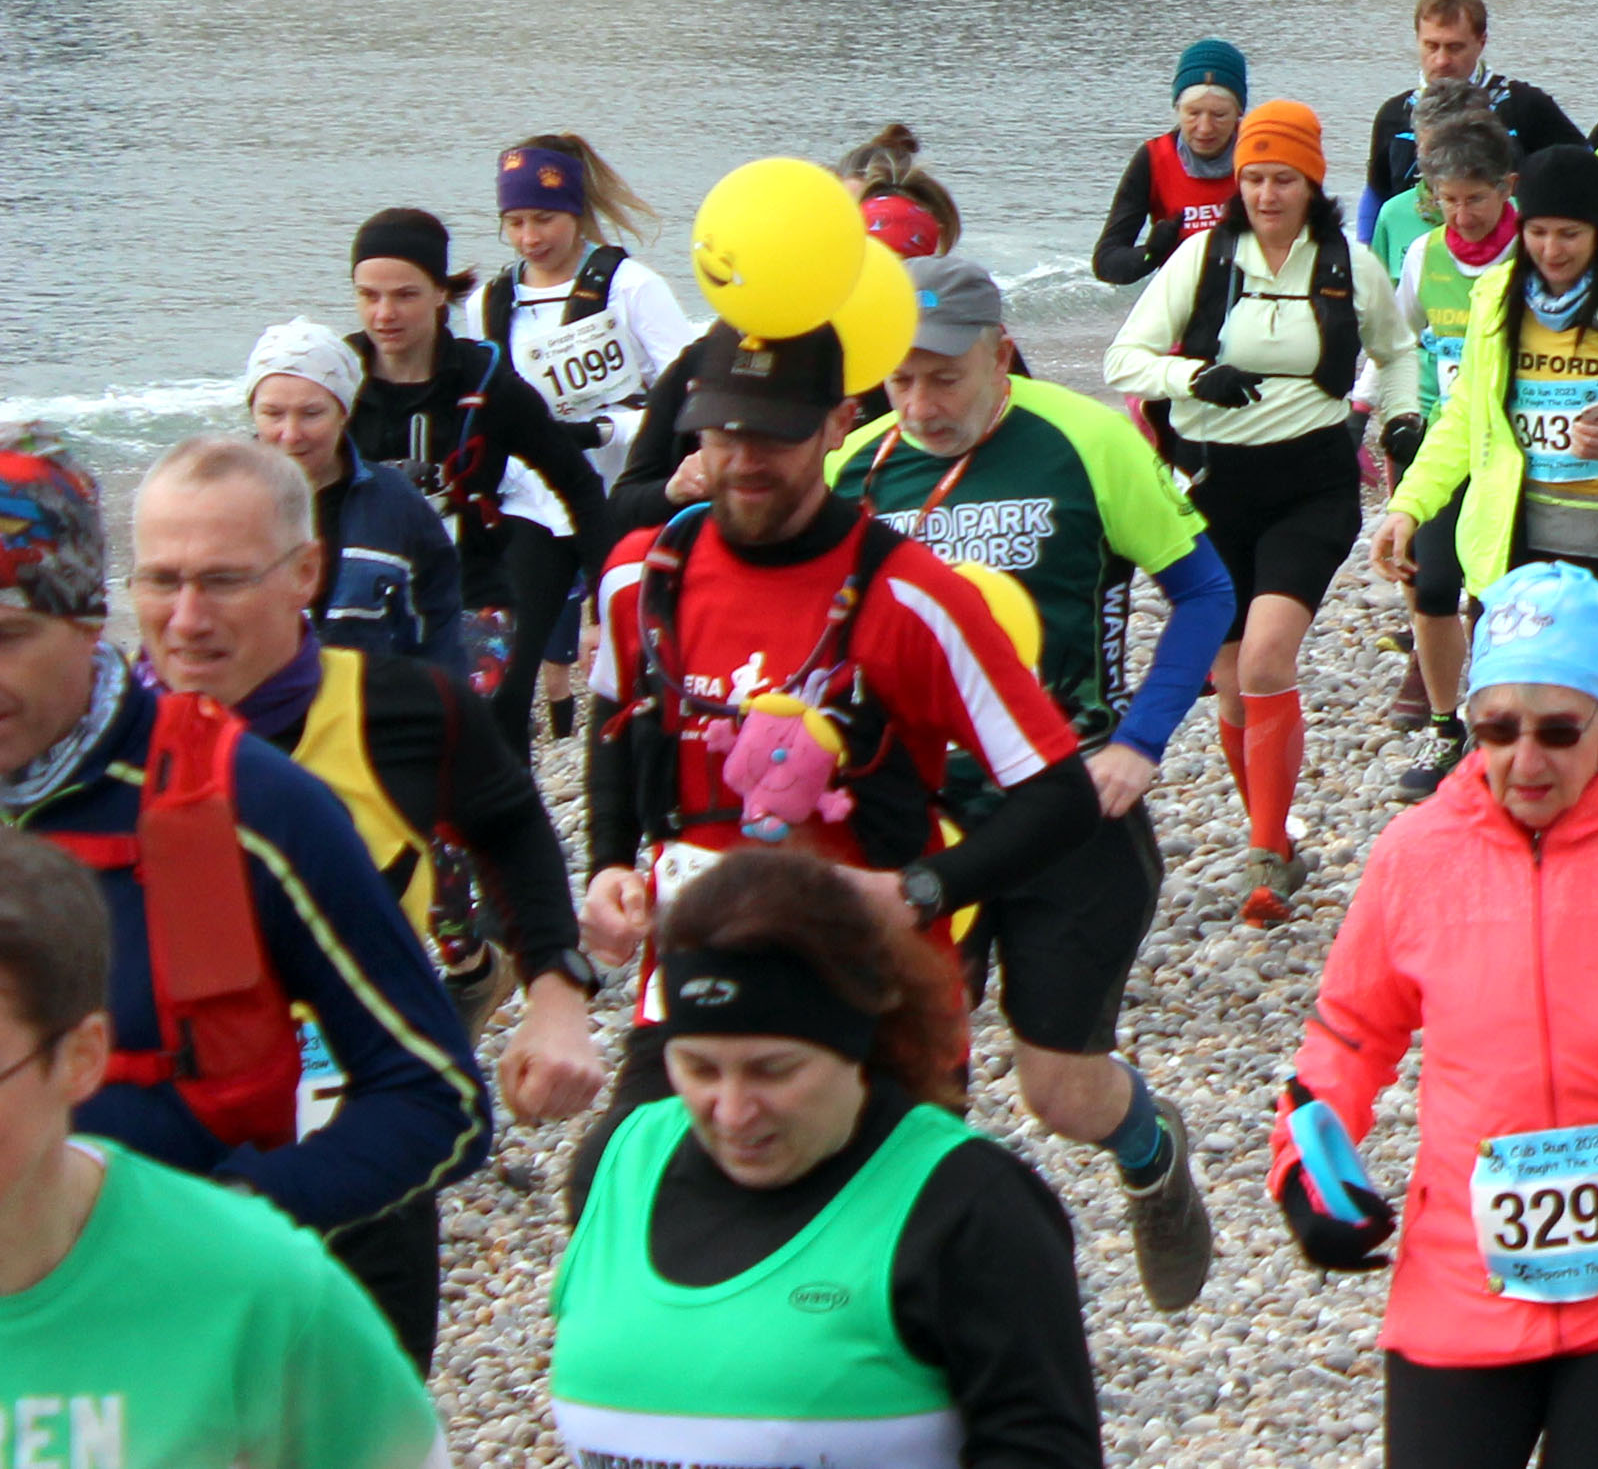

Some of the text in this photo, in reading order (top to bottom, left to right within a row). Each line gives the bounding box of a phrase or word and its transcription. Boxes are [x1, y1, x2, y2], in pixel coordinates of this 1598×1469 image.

[542, 339, 625, 397] 1099
[1515, 413, 1582, 451] 343
[951, 499, 1055, 541] PARK
[1543, 1141, 1569, 1154] Run
[0, 1395, 127, 1469] EN
